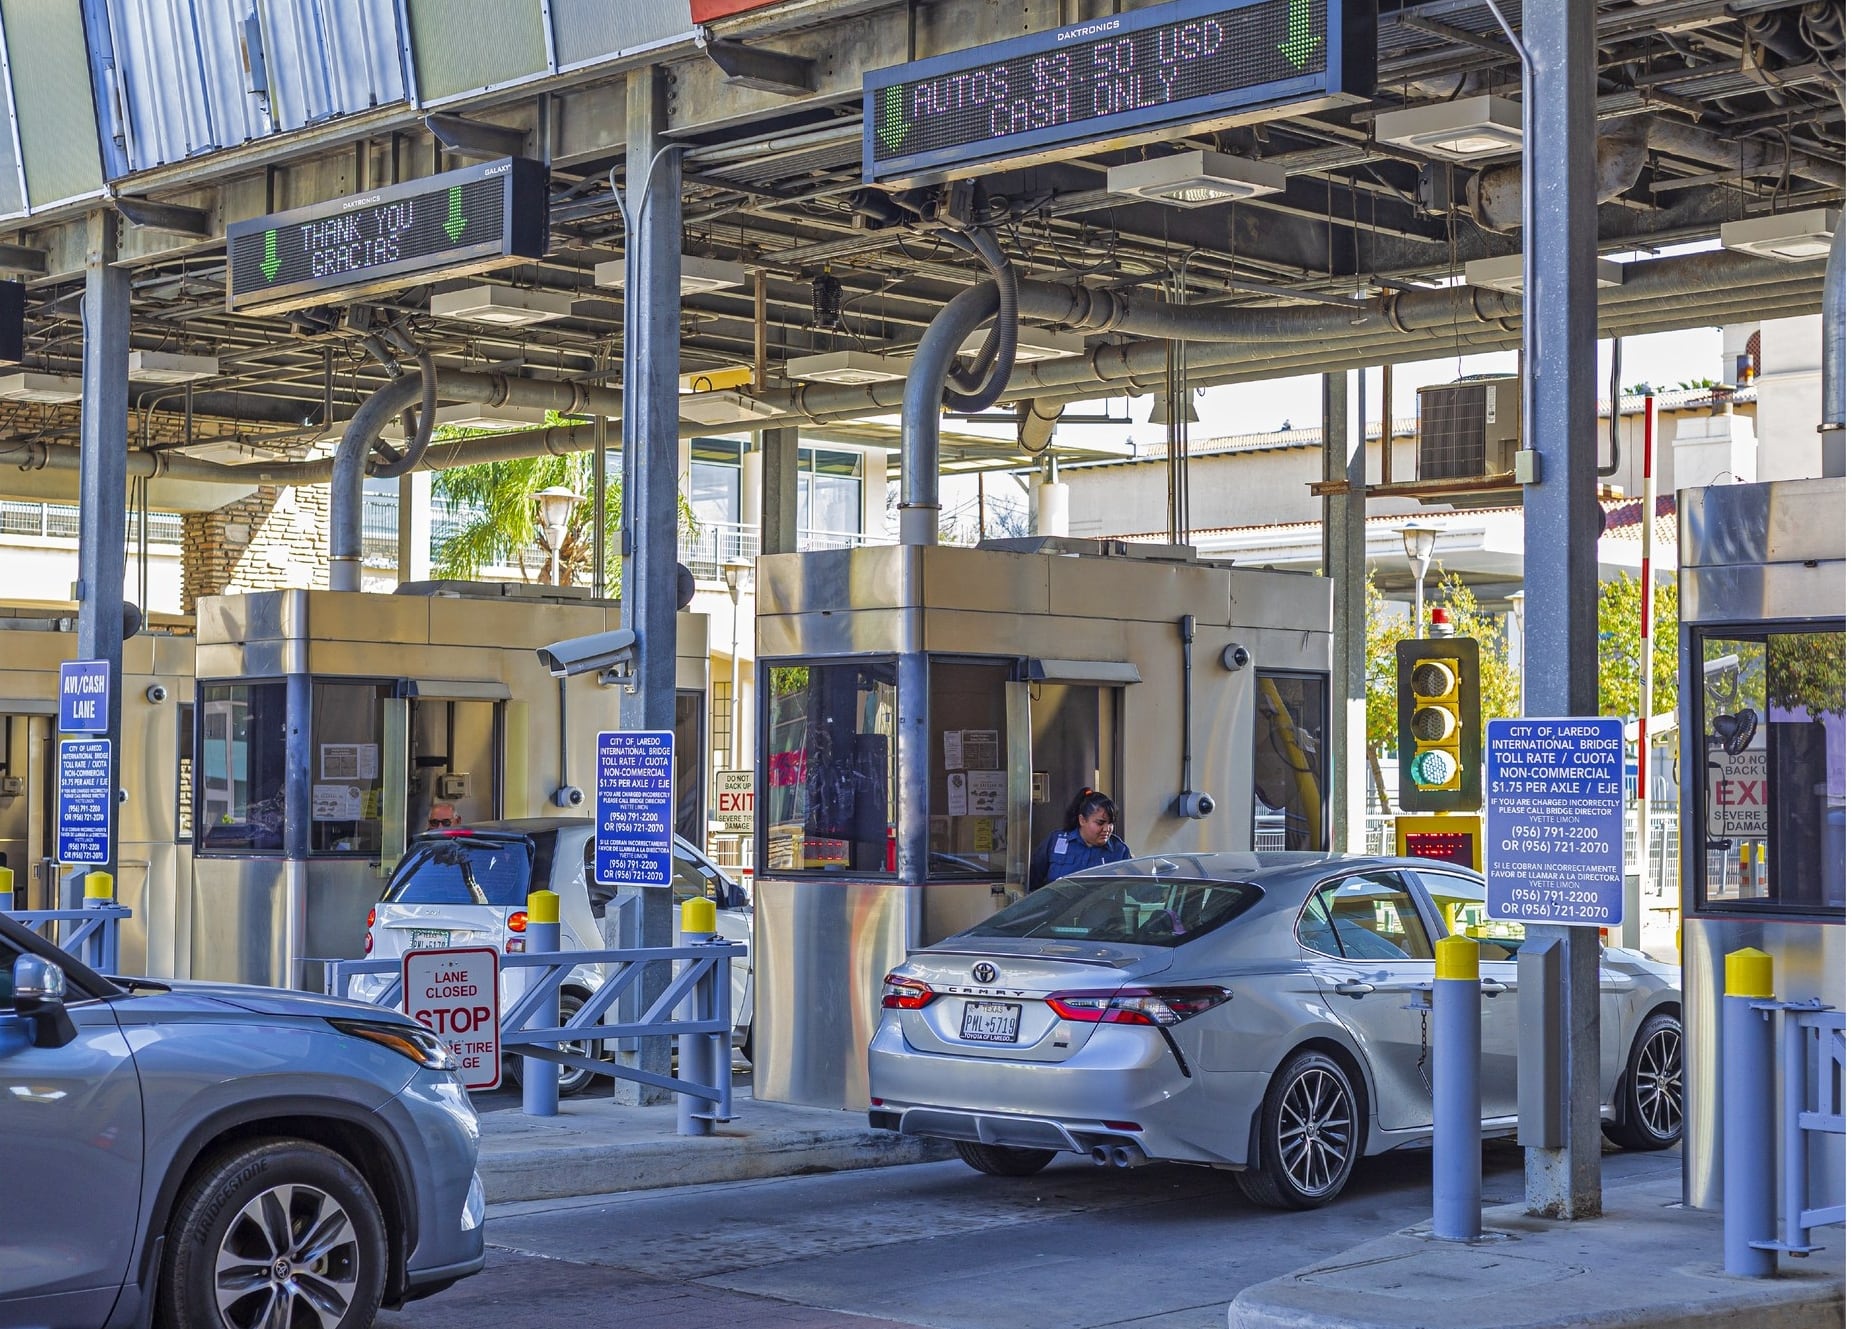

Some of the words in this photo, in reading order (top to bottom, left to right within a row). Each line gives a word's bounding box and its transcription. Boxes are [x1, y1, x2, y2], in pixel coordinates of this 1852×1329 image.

[1058, 20, 1120, 41] DAKTRONICS
[914, 67, 1008, 117] AUTOS
[1032, 39, 1134, 91] $3.50
[1159, 20, 1223, 64] USD
[992, 90, 1069, 136] CASH
[1094, 67, 1177, 115] ONLY
[301, 213, 361, 251] THANK
[375, 202, 412, 234] YOU
[312, 234, 399, 277] GRACIAS
[64, 675, 104, 695] AVI/CASH
[73, 701, 95, 718] LANE
[1510, 727, 1532, 736] CITY
[1538, 727, 1552, 736] OF
[1558, 727, 1600, 736] LAREDO
[1492, 740, 1574, 749] INTERNATIONAL
[1580, 740, 1618, 749] BRIDGE
[1495, 753, 1523, 763] TOLL
[1527, 753, 1555, 763] RATE
[1574, 753, 1615, 763] CUOTA
[1729, 756, 1745, 764] DO
[1750, 755, 1767, 764] NO
[604, 768, 665, 776] NON-COMMERCIAL
[1500, 768, 1610, 778] NON-COMMERCIAL
[1726, 766, 1758, 775] BACK
[600, 779, 617, 787] $1.75
[1492, 782, 1522, 793] $1.75
[1526, 783, 1547, 792] PER
[1550, 783, 1580, 793] AXLE
[1598, 783, 1618, 793] EJE
[1716, 781, 1767, 805] EXI
[720, 793, 754, 811] EXIT
[610, 812, 626, 821] (956)
[628, 813, 658, 821] 791-2200
[1714, 811, 1760, 820] SEVERE
[604, 823, 614, 831] OR
[616, 823, 632, 832] (956)
[634, 824, 664, 832] 721-2070
[1727, 822, 1767, 830] DAMA
[1512, 826, 1540, 838] (956)
[1544, 827, 1598, 838] 791-2200
[1502, 840, 1518, 850] OR
[1522, 840, 1550, 853] (956)
[1554, 842, 1608, 853] 721-2070
[610, 860, 625, 868] (956)
[628, 860, 657, 869] 791-2200
[1544, 864, 1616, 872] INCORRECTAMENTE
[604, 870, 613, 878] OR
[615, 870, 631, 880] (956)
[633, 871, 663, 880] 721-2070
[1578, 874, 1620, 882] DIRECTORA
[1512, 889, 1540, 901] (956)
[1544, 891, 1597, 902] 791-2200
[1502, 903, 1518, 913] OR
[1522, 904, 1550, 916] (956)
[1554, 905, 1608, 917] 721-2070
[435, 971, 468, 983] LANE
[426, 985, 477, 998] CLOSED
[949, 987, 1024, 996] CAMRY
[415, 1006, 490, 1034] STOP
[465, 1042, 493, 1054] TIRE
